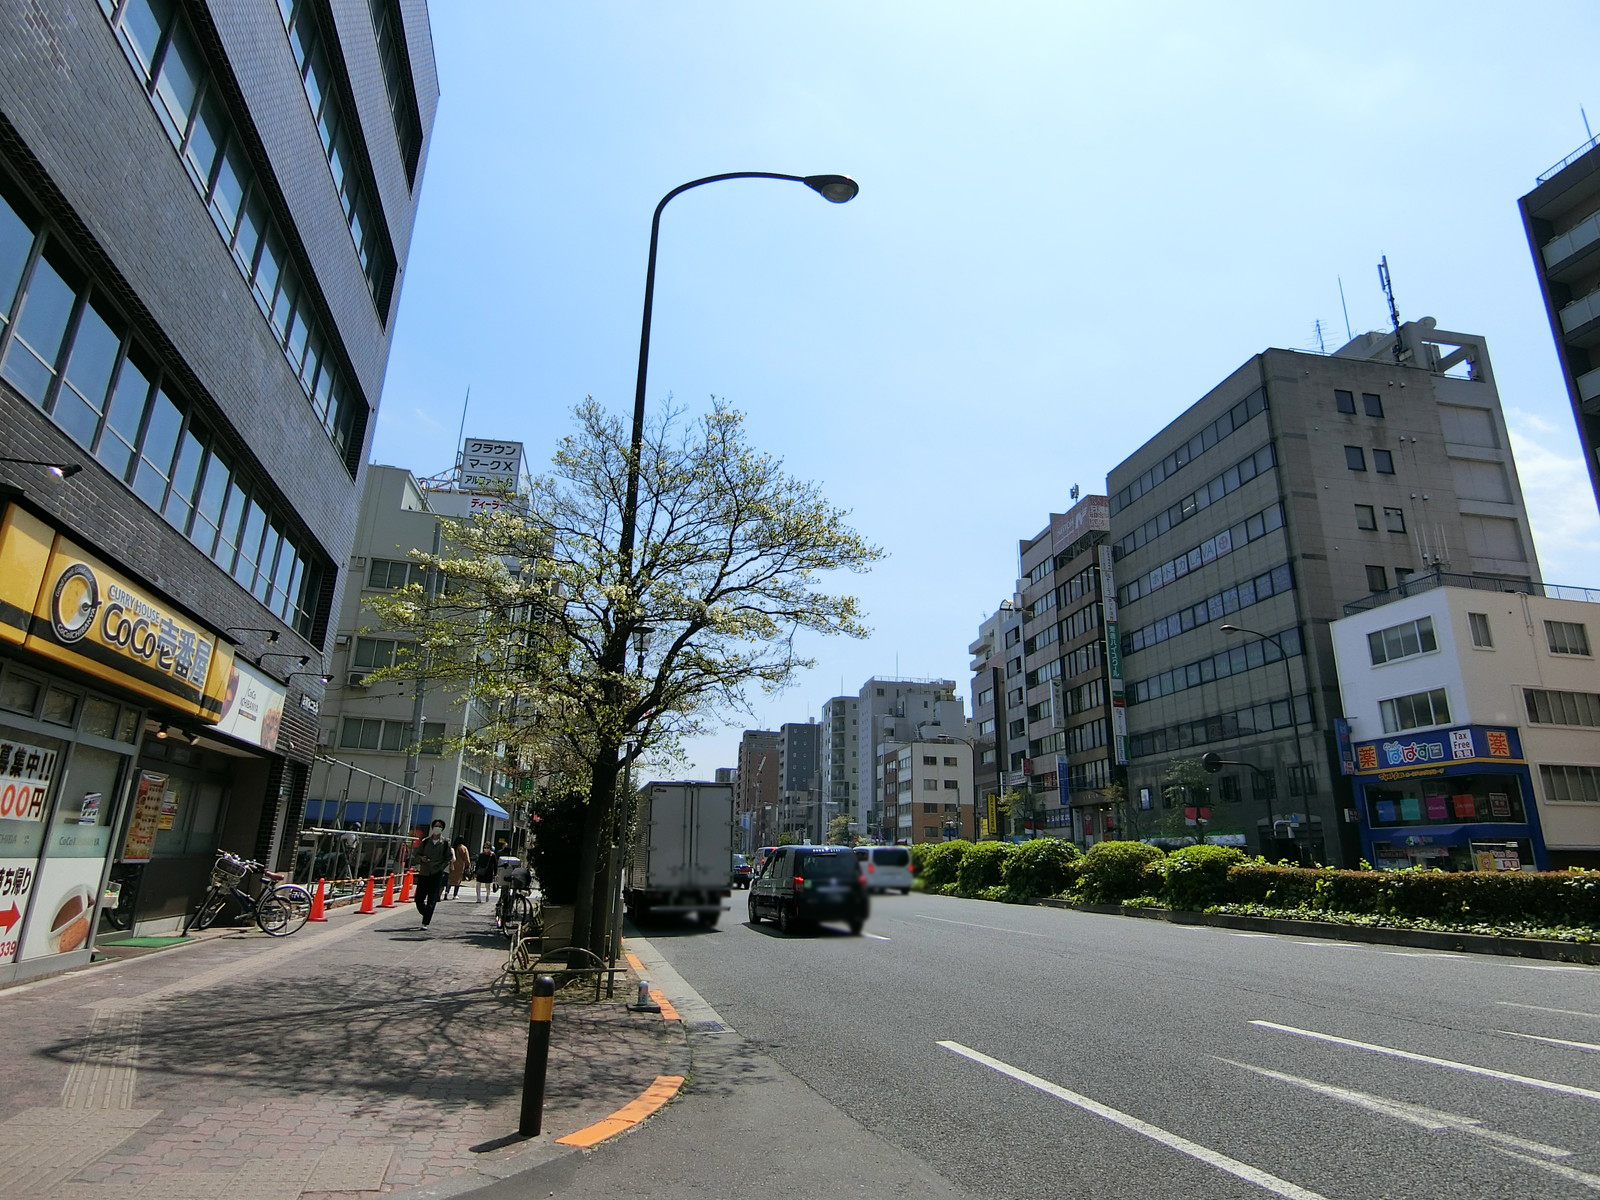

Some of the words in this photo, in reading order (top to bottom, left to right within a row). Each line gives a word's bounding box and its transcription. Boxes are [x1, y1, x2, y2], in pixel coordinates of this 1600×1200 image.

[471, 443, 516, 456] クラウン
[469, 459, 513, 471] マークX
[1190, 546, 1214, 567] LAVA
[110, 584, 135, 609] CURRY
[135, 601, 160, 624] HOUSE
[1453, 732, 1467, 740] Tax
[1453, 741, 1470, 750] Free
[1488, 732, 1507, 755] 薬
[1358, 746, 1376, 767] 薬
[0, 784, 46, 818] 00円
